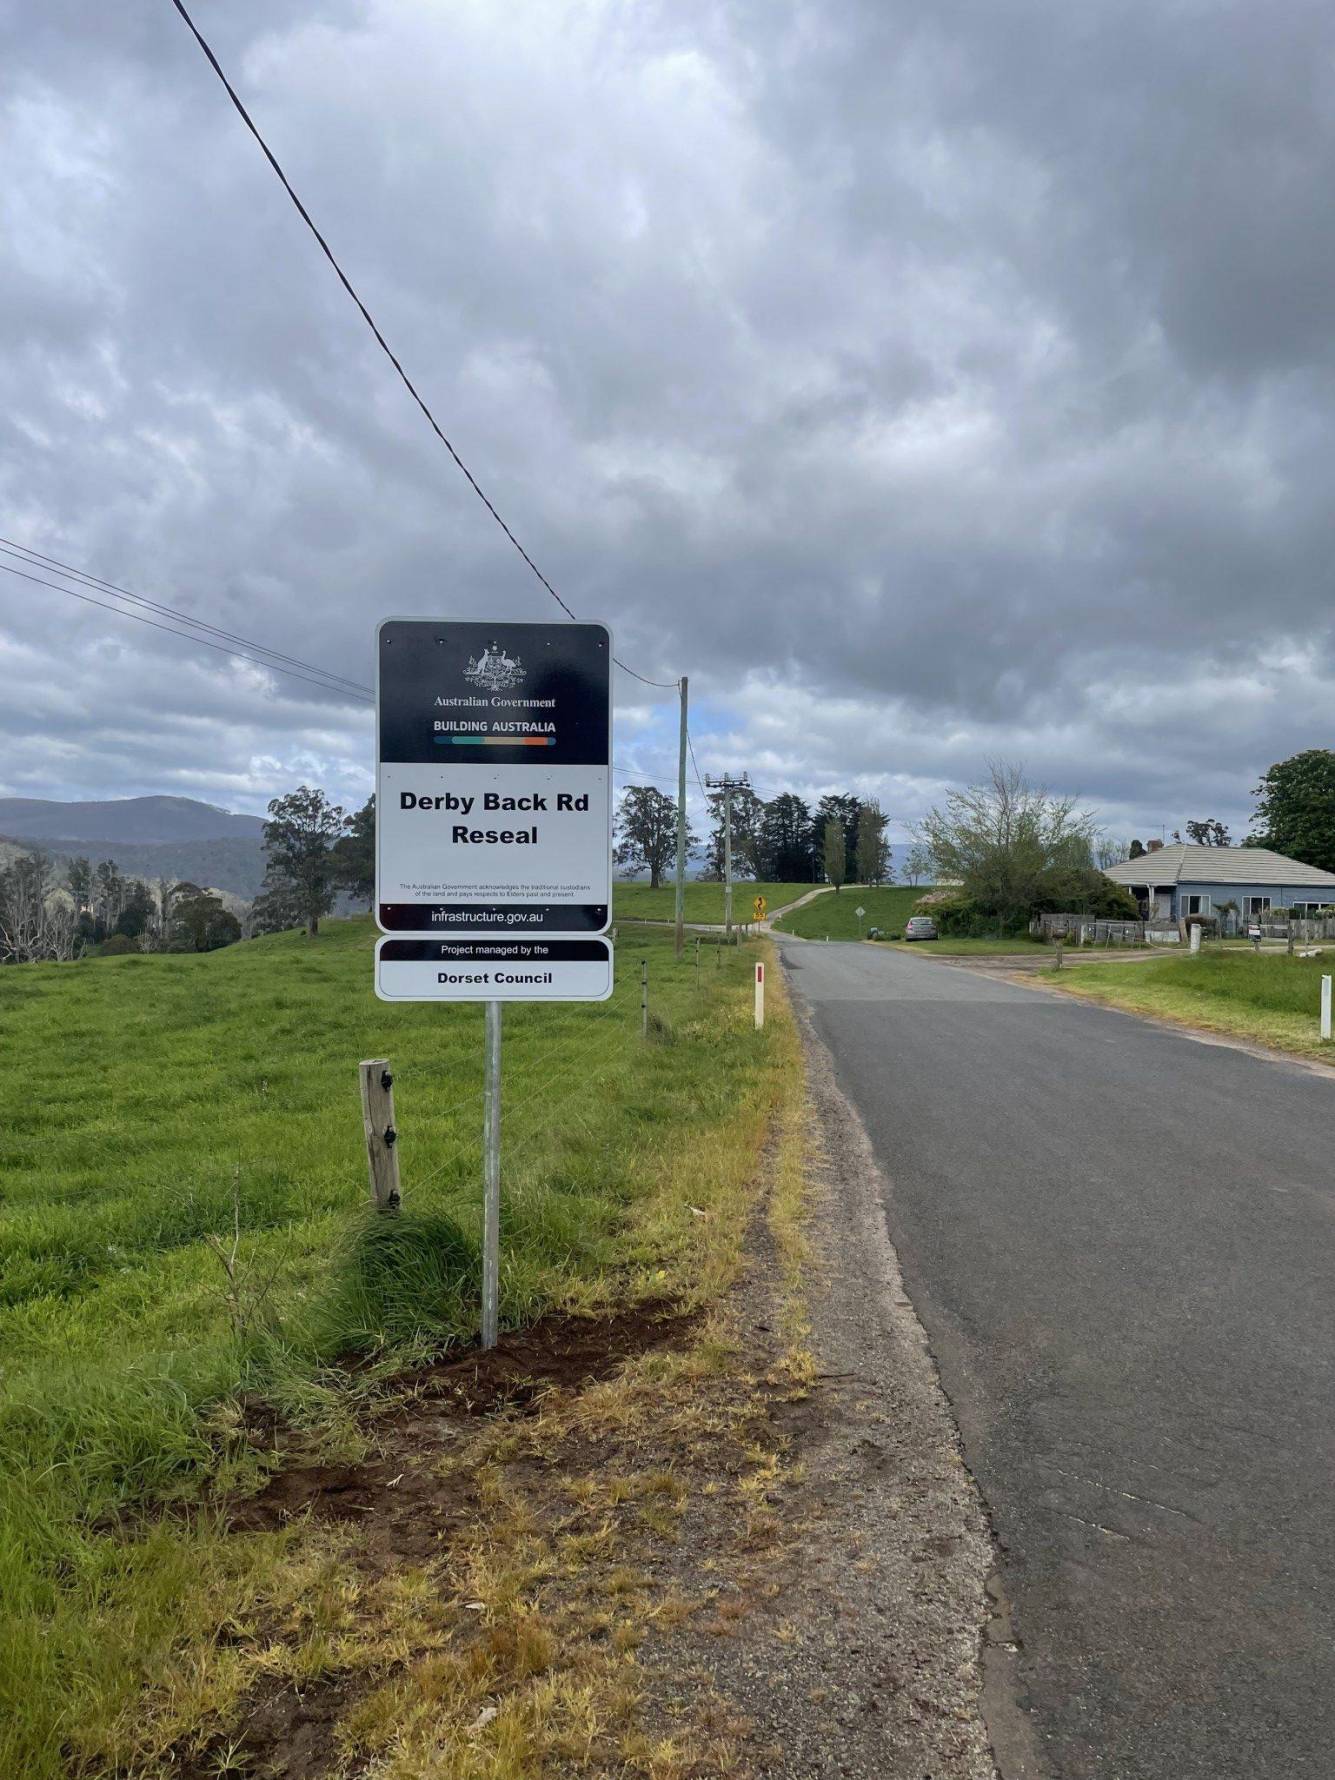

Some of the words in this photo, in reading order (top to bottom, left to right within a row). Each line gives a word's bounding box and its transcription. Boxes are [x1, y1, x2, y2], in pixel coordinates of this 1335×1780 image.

[434, 696, 488, 708] Australian
[491, 696, 556, 708] Government
[434, 721, 488, 732] BUILDING
[492, 721, 556, 733] AUSTRALIA
[400, 792, 475, 815] Derby
[483, 793, 548, 811] Back
[557, 793, 589, 812] Rd
[452, 825, 538, 844] Reseal
[431, 910, 544, 924] infrastructure.gov.au
[441, 945, 473, 955] Project
[475, 945, 518, 955] managed
[520, 945, 532, 955] by
[534, 945, 549, 954] the
[437, 972, 489, 984] Dorset
[494, 972, 552, 984] Council
